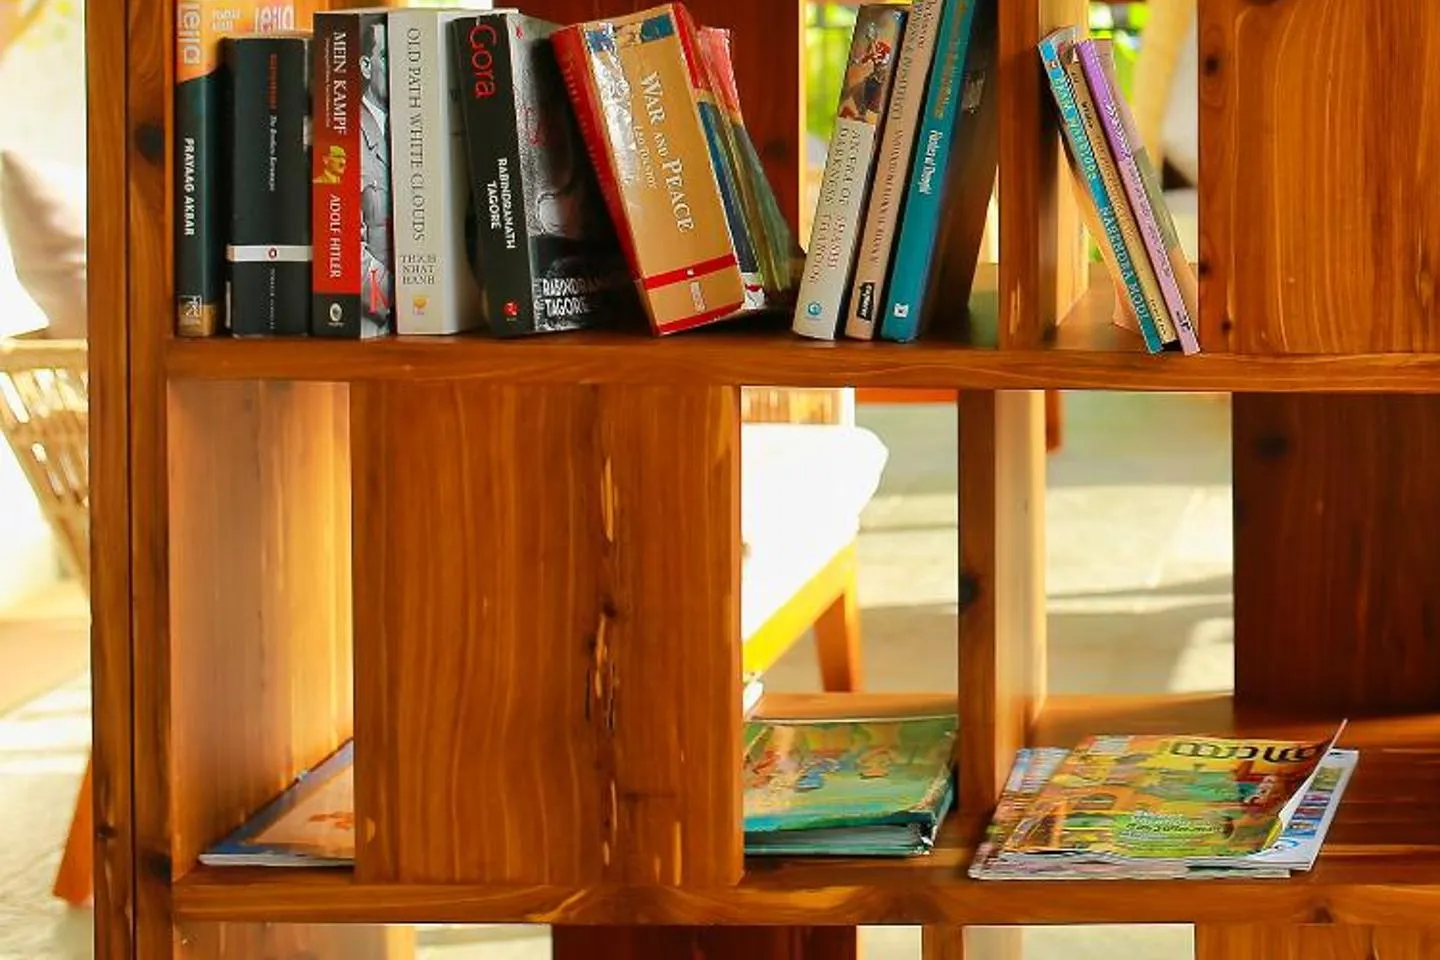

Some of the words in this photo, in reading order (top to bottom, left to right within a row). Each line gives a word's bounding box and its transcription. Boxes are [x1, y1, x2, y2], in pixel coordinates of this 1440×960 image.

[333, 31, 346, 73] MEIN
[406, 27, 421, 62] OLD
[465, 22, 502, 99] Gora
[333, 79, 346, 134] KAMPF
[408, 67, 422, 108] PATH
[638, 71, 670, 126] WAR
[183, 138, 194, 192] PRAYAAG
[409, 113, 424, 167] WHITE
[652, 130, 670, 158] AND
[823, 127, 850, 204] DARKNESS
[183, 195, 193, 235] AKBAR
[329, 194, 340, 233] ADOLF
[409, 173, 426, 241] CLOUDS
[485, 180, 501, 229] TAGORE
[495, 157, 516, 249] RABINDRANATH
[660, 157, 697, 234] PEACE
[329, 237, 340, 277] HITLER
